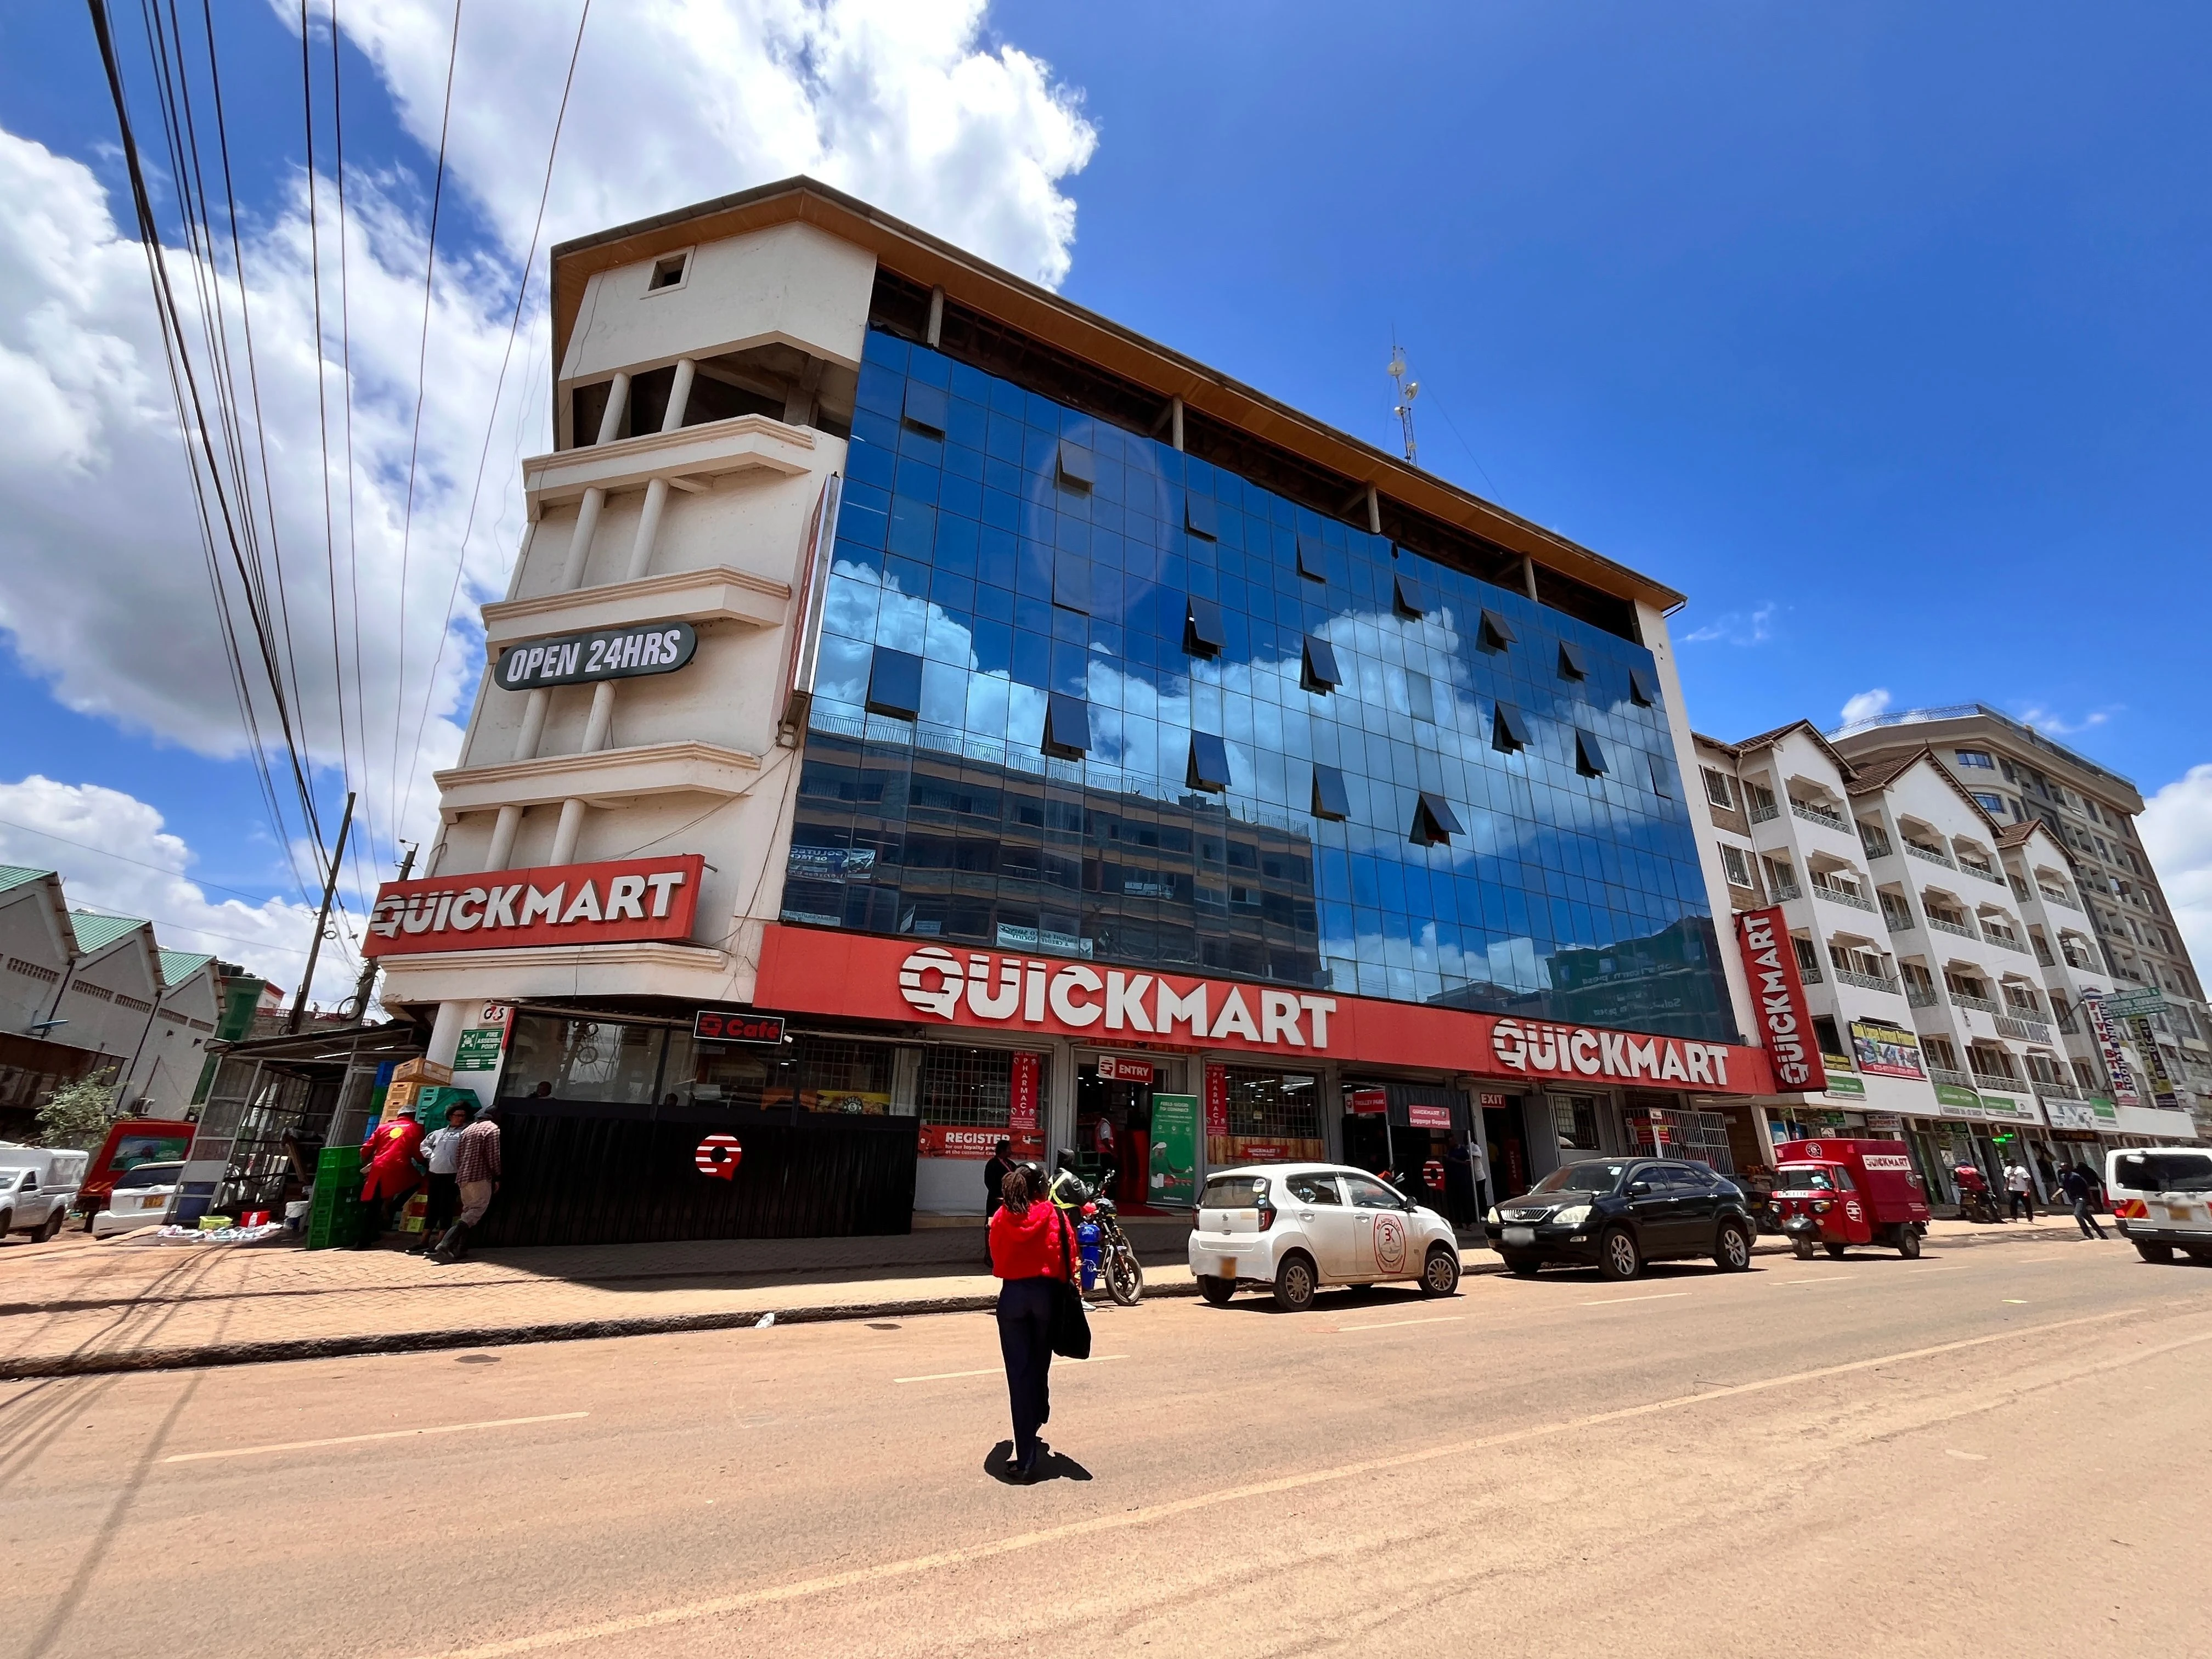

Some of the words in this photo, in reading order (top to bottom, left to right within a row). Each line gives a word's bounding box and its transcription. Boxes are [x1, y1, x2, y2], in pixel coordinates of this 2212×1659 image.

[506, 642, 580, 682] OPEN
[584, 629, 680, 673] 24HRS
[370, 871, 686, 940] QUICKMART
[899, 946, 1336, 1049] QUICKMART
[1743, 916, 1809, 1084] QUICKMART
[726, 1018, 780, 1039] Café
[1492, 1019, 1729, 1086] QUICKMART
[1020, 1058, 1028, 1116] PHARMACY
[1119, 1064, 1149, 1076] ENTRY
[1481, 1094, 1502, 1104] EXIT
[945, 1132, 1010, 1144] REGISTER
[1866, 1157, 1909, 1168] QUICKMART
